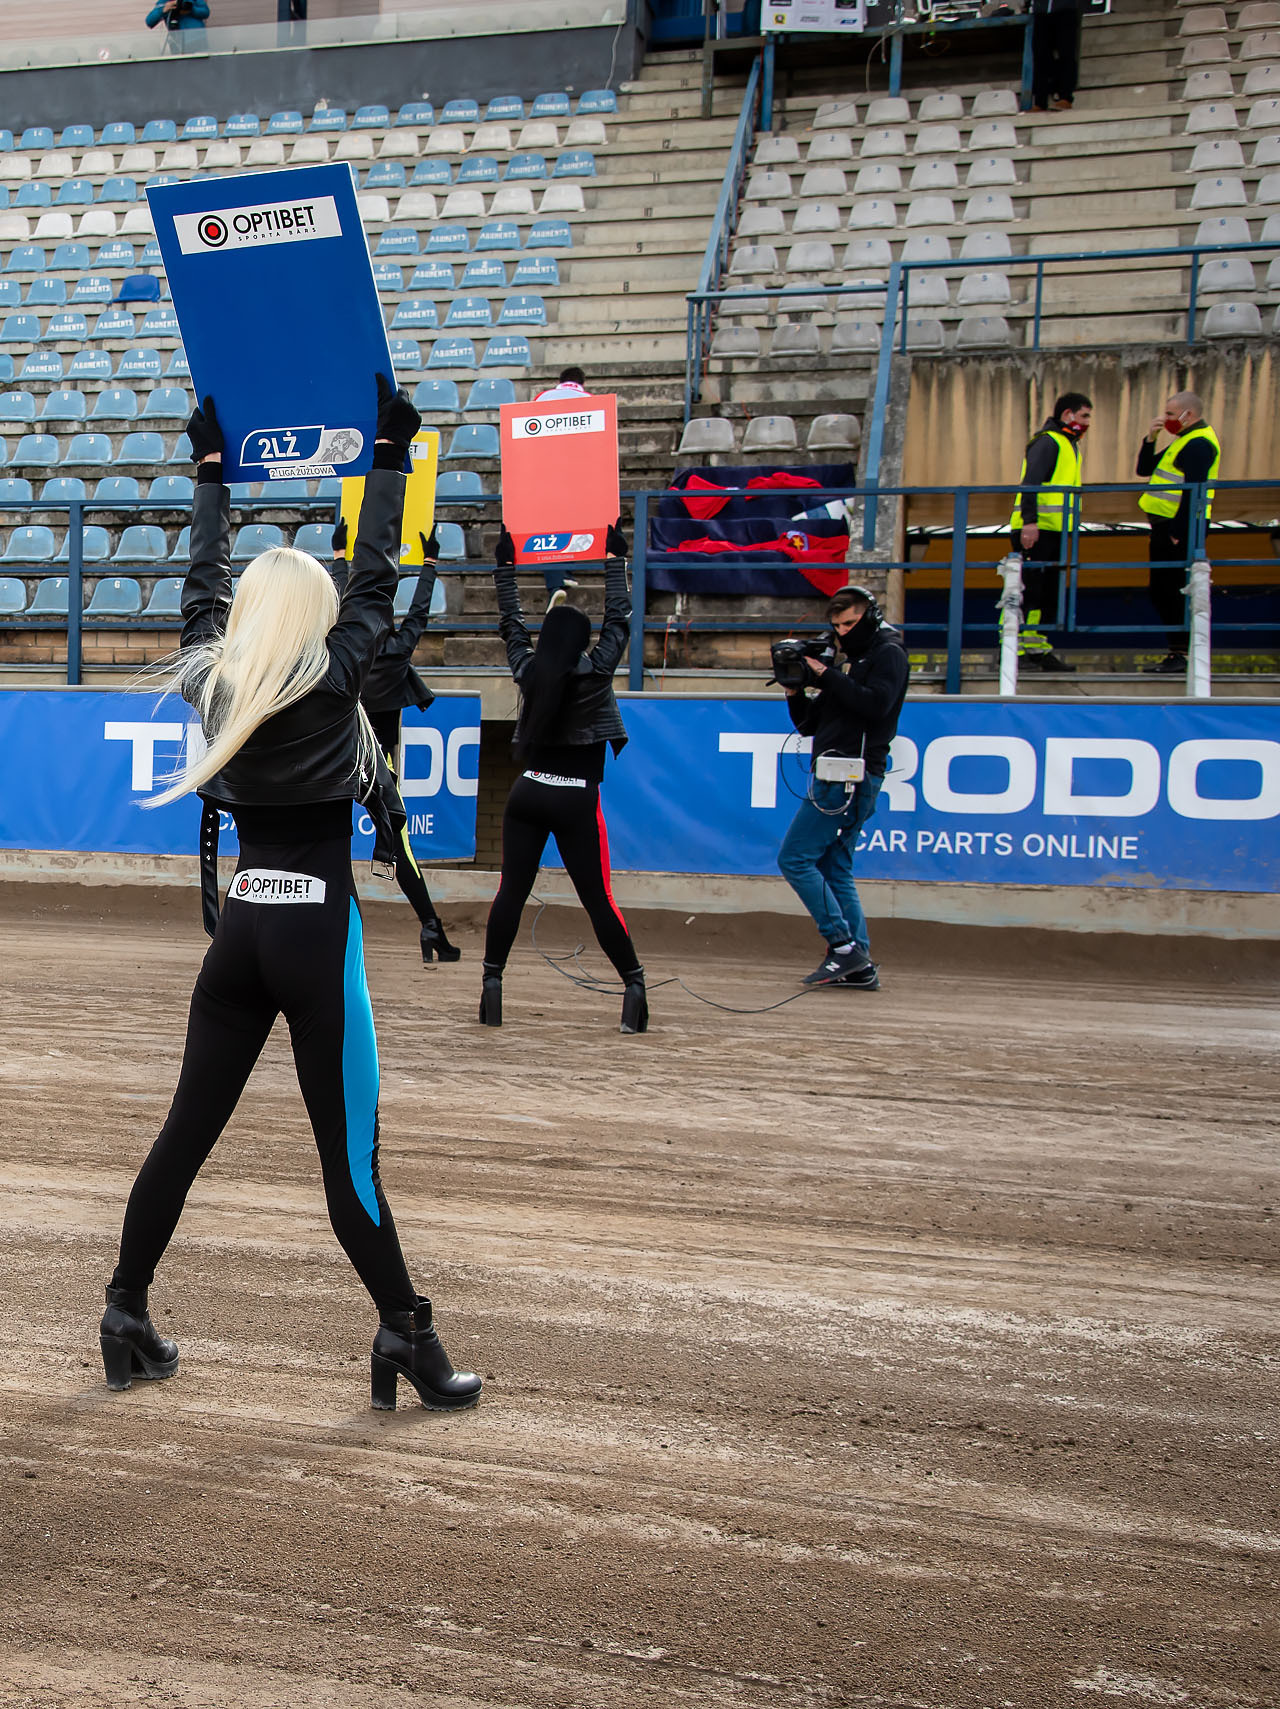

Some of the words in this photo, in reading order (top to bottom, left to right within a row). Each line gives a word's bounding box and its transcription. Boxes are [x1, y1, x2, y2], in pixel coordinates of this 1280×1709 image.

[232, 206, 315, 234] OPTIBET
[238, 231, 281, 242] SPORTA
[613, 321, 621, 332] 7
[545, 415, 593, 429] OPTIBET
[257, 431, 301, 459] 2LŻ
[279, 468, 296, 478] LIGA
[532, 534, 558, 551] 2LŻ
[916, 830, 1013, 856] PARTS
[1022, 833, 1139, 860] ONLINE
[251, 878, 313, 895] OPTIBET
